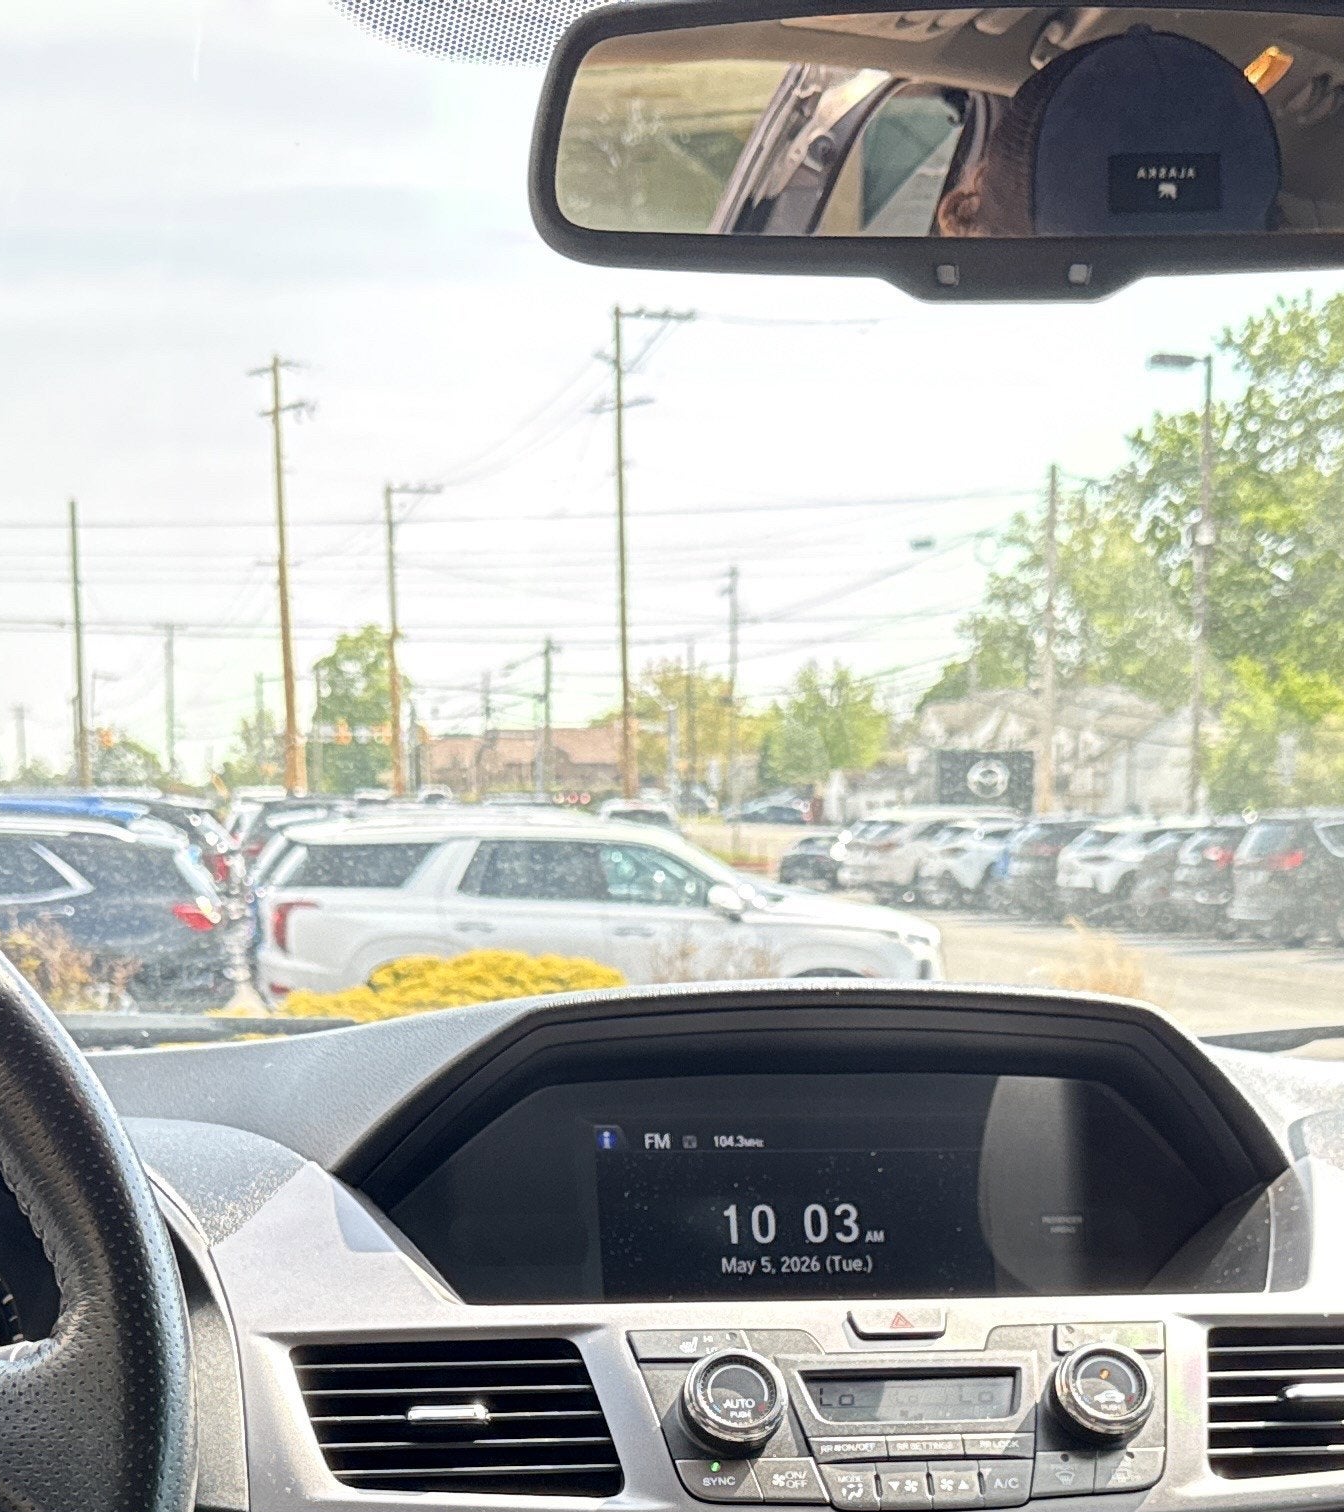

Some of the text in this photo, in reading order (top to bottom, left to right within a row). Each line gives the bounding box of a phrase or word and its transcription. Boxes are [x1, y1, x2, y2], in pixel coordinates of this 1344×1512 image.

[644, 1132, 672, 1149] FM
[722, 1203, 885, 1244] 10 03 AM
[721, 1255, 873, 1274] May 5, 2026 (Tue.)
[722, 1399, 755, 1410] AUTO
[702, 1476, 736, 1487] SYNC
